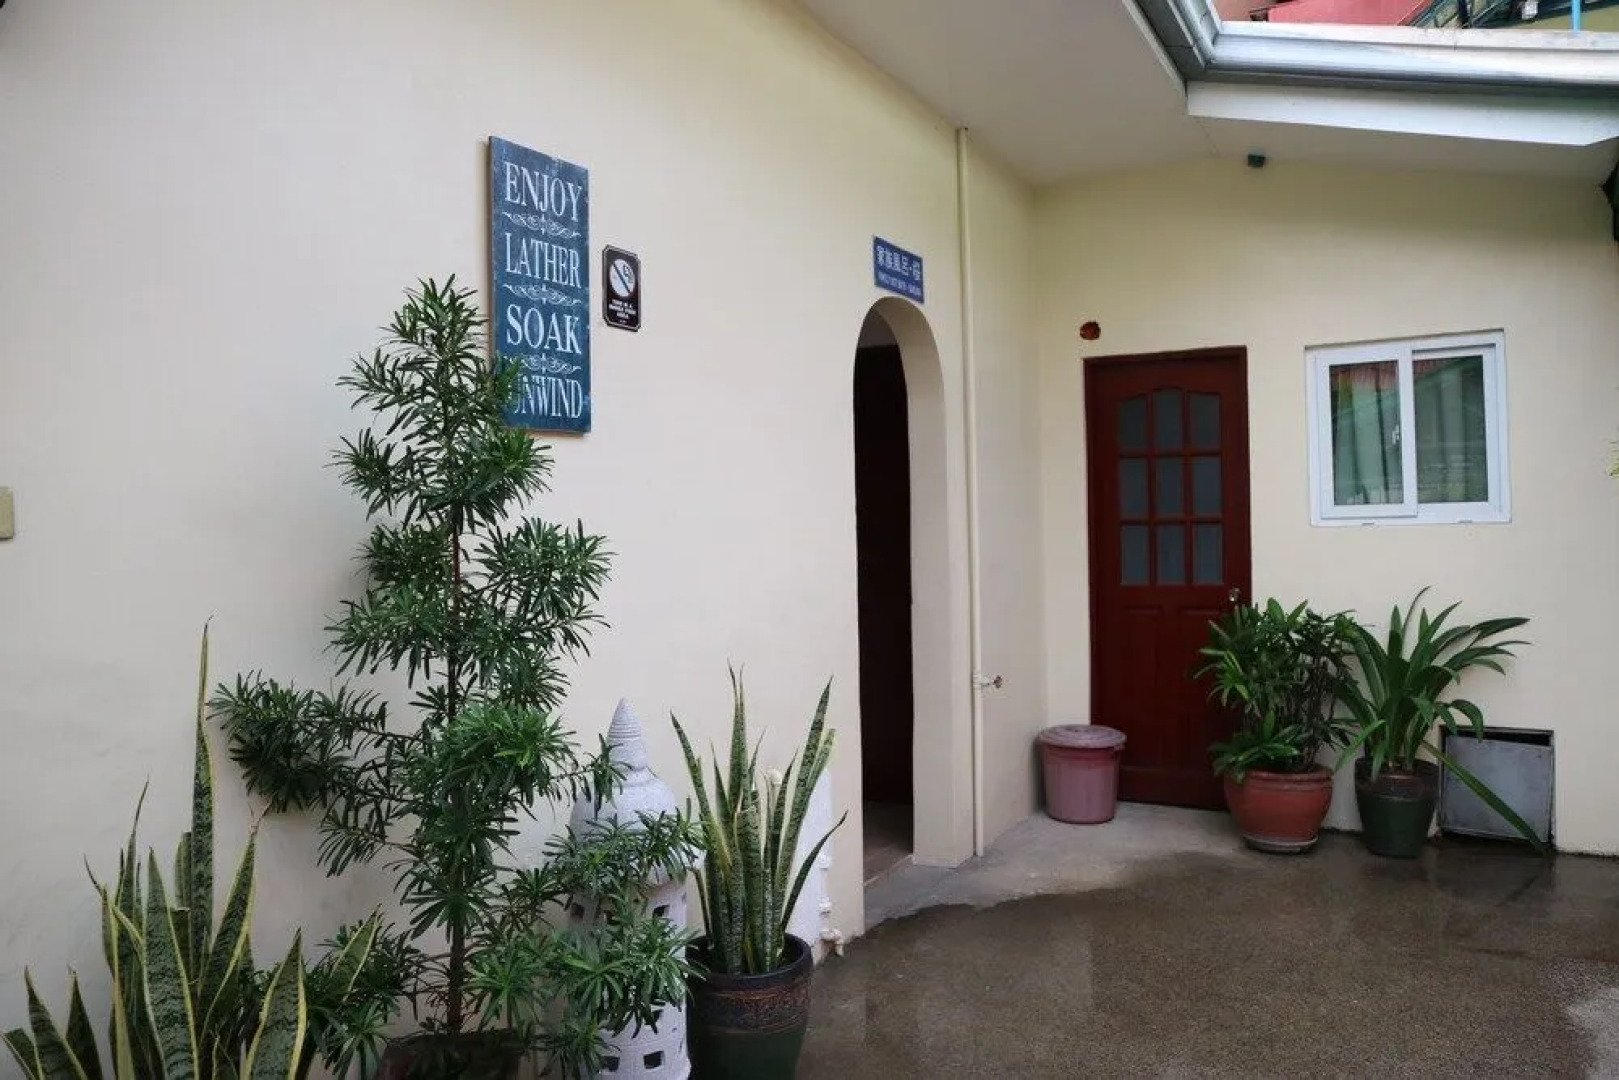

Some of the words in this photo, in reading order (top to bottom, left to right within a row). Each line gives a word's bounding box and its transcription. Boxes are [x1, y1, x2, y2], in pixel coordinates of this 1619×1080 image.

[504, 161, 582, 223] ENJOY
[505, 232, 582, 289] LATHER
[506, 303, 582, 355] SOAK
